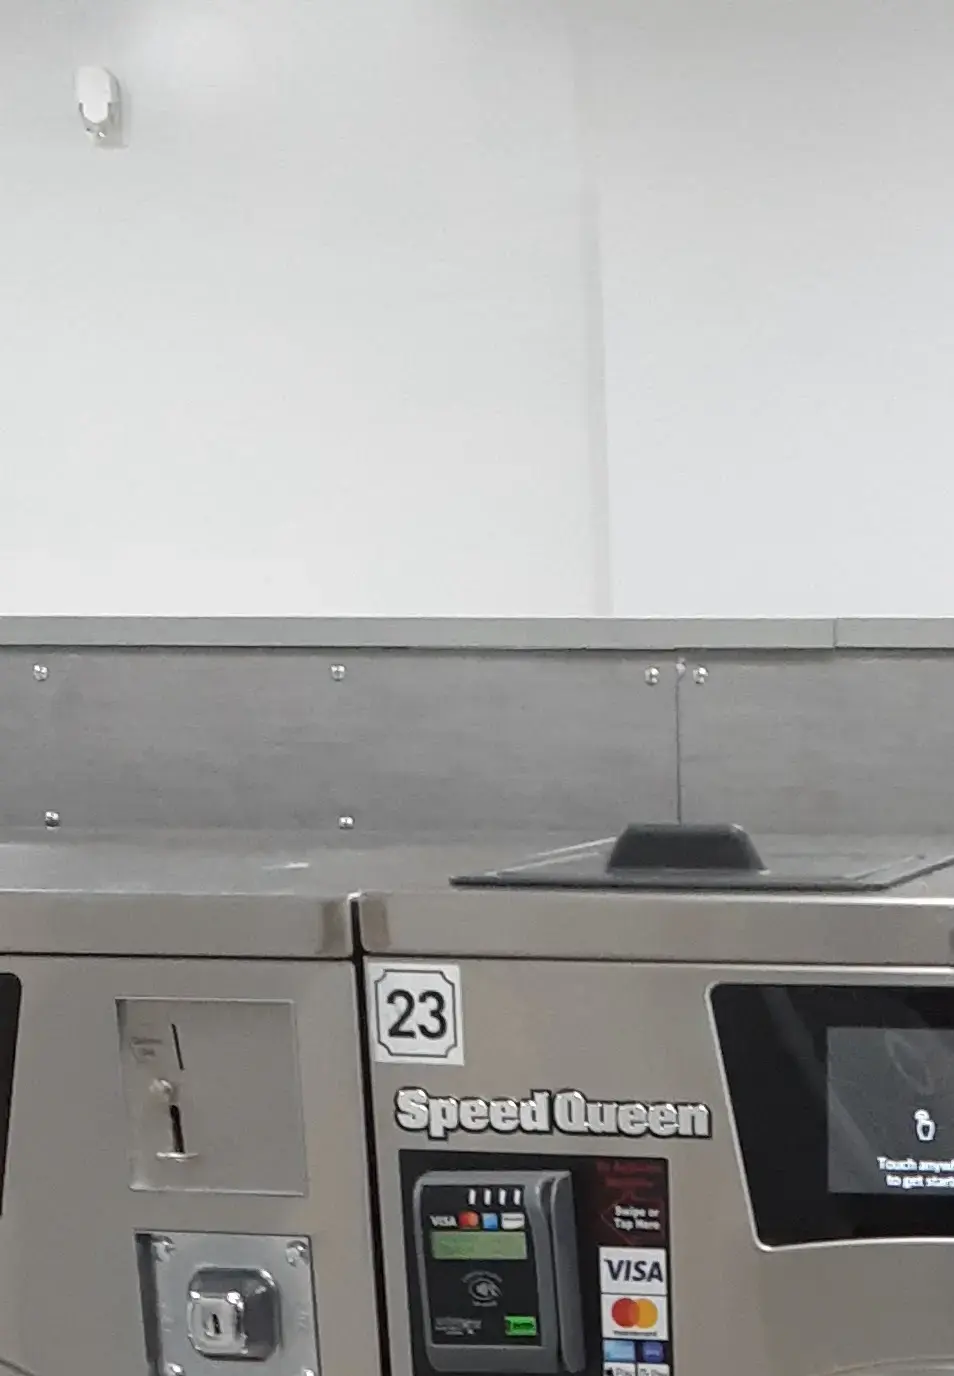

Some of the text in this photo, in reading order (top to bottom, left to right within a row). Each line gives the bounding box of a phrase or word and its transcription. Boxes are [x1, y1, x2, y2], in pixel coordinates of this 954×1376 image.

[386, 988, 448, 1040] 23
[394, 1086, 712, 1139] Speed Queen
[877, 1155, 918, 1170] Touch
[886, 1174, 902, 1187] to
[902, 1175, 924, 1189] get
[430, 1214, 457, 1227] VISA
[613, 1217, 634, 1231] Tap
[603, 1258, 663, 1283] VISA
